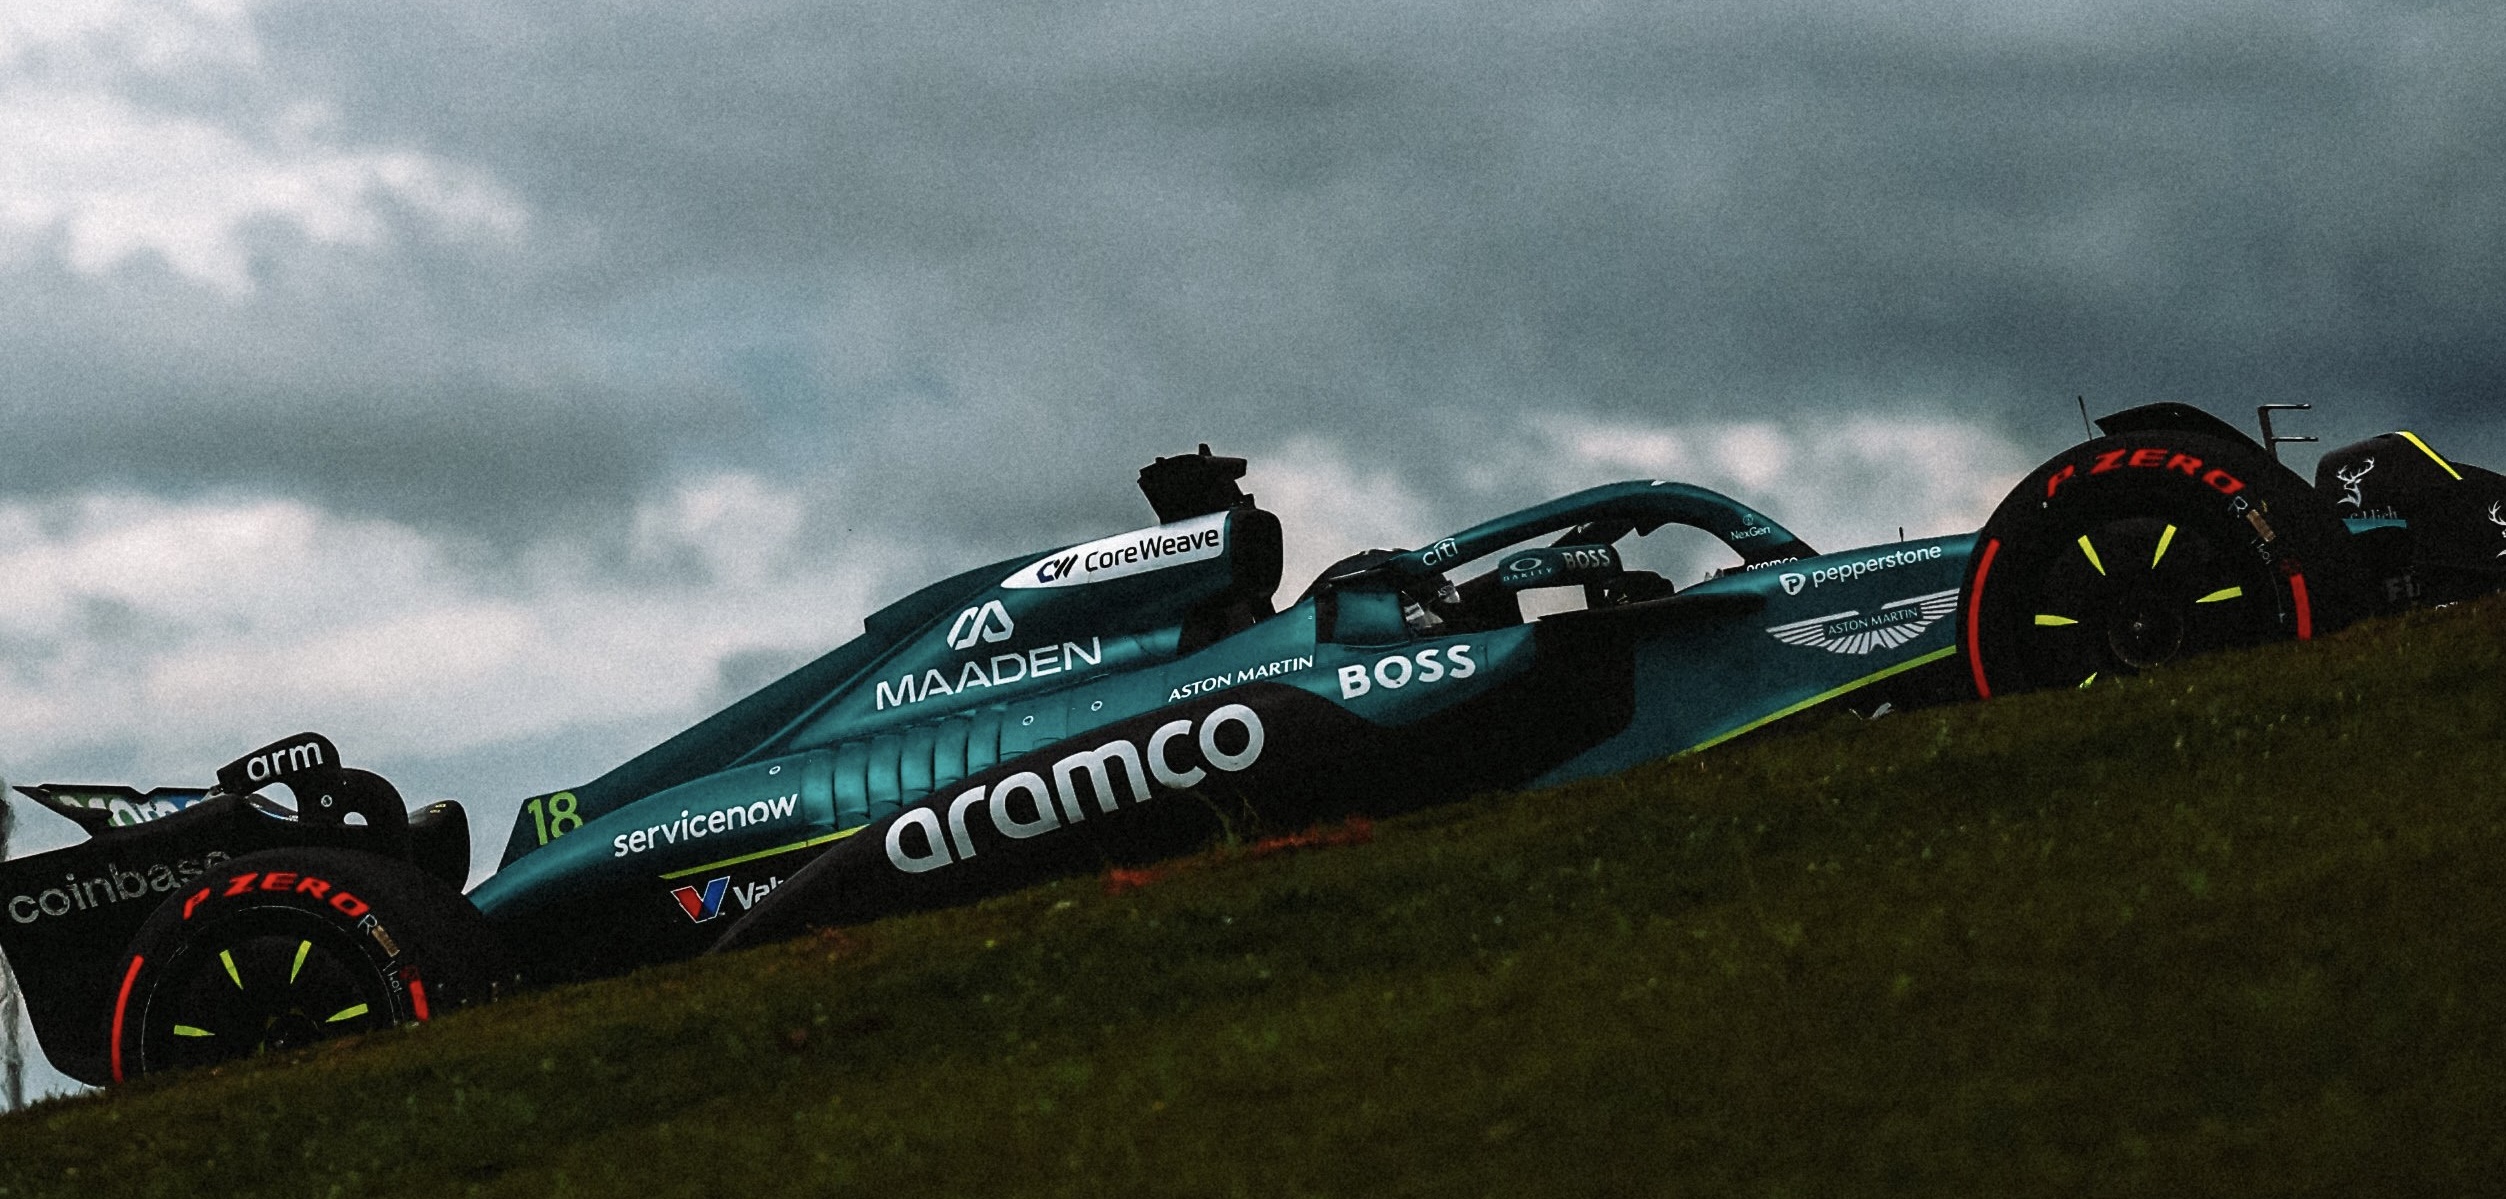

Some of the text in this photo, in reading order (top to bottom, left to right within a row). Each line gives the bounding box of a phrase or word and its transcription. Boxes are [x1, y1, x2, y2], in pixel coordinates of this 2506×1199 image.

[2090, 448, 2247, 495] ZERO
[1085, 529, 1219, 572] CoreWeave
[1422, 537, 1458, 566] citi
[1730, 526, 1771, 540] NexGen
[1562, 548, 1610, 569] BOSS
[1812, 545, 1942, 588] pepperstone
[1828, 607, 1918, 635] ASTON MARTIN
[876, 636, 1101, 711] MAADEN
[1168, 655, 1314, 702] ASTON MARTIN
[1337, 645, 1476, 700] BOSS
[247, 740, 324, 782] arm
[885, 703, 1264, 873] aramco
[527, 791, 584, 845] 18
[614, 794, 798, 858] servicenow
[223, 871, 372, 918] ZERO
